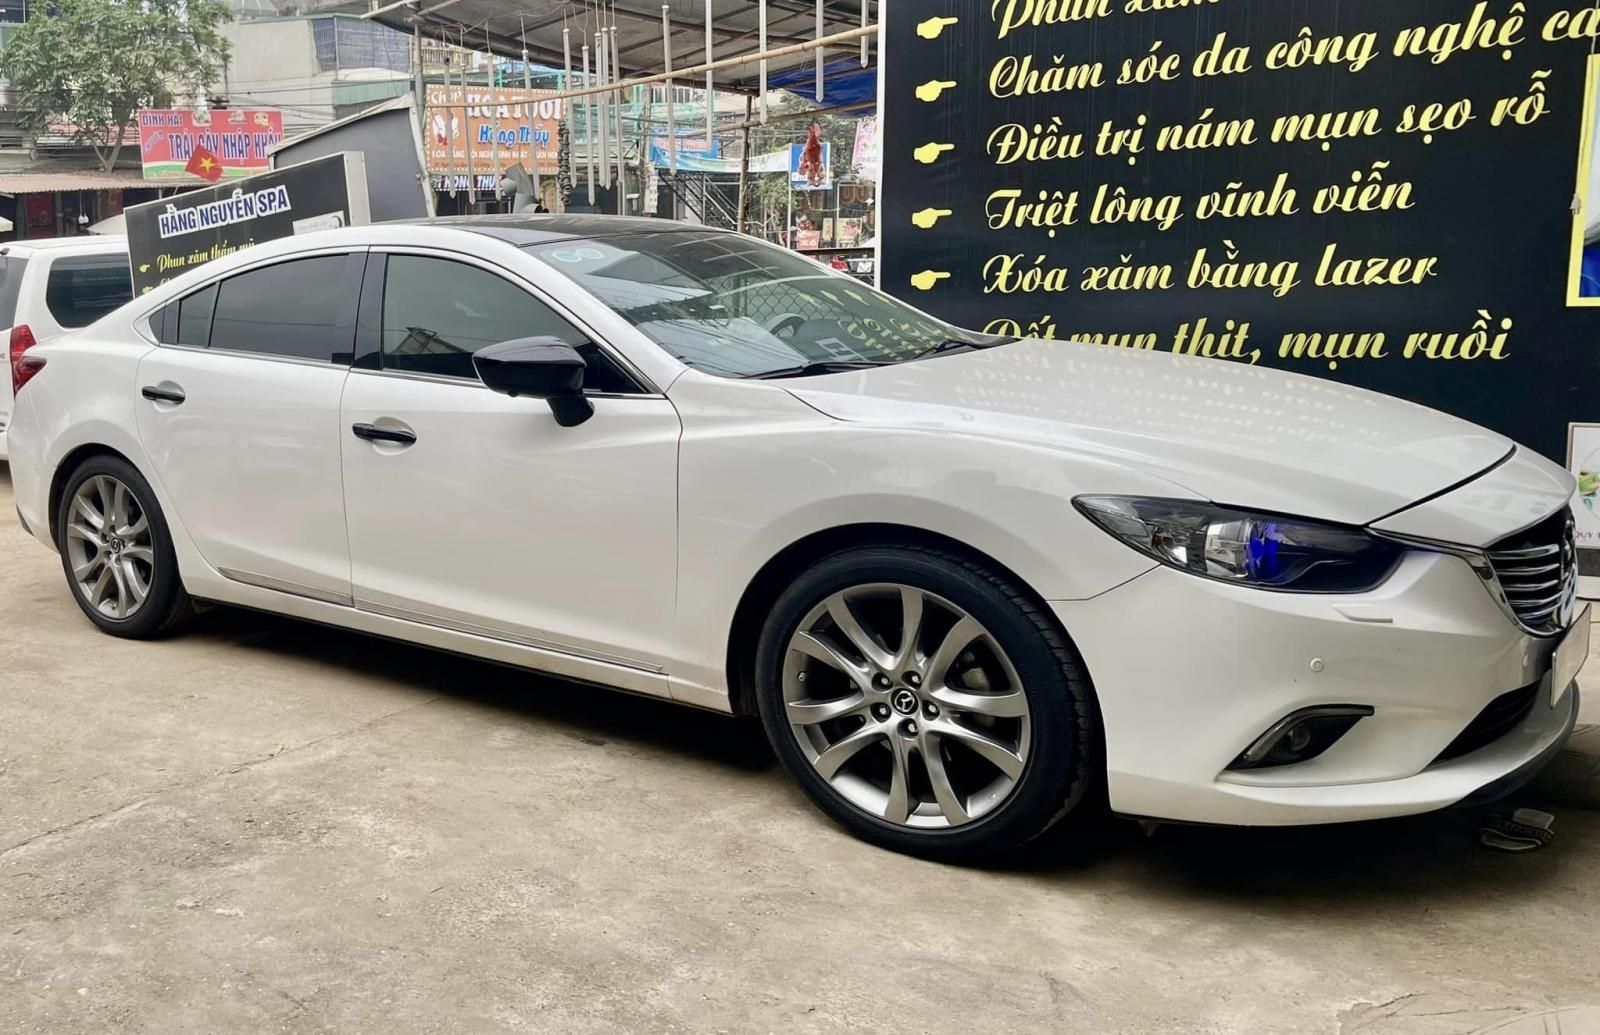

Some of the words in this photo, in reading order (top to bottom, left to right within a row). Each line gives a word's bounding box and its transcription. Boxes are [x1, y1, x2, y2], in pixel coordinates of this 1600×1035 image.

[989, 54, 1105, 98] Chăm
[1116, 40, 1180, 84] sóc
[1192, 32, 1251, 77] da
[1265, 26, 1379, 72] công
[1393, 1, 1525, 64] nghệ
[479, 121, 515, 148] Hng
[987, 116, 1083, 164] Điều
[1095, 114, 1147, 165] trị
[1156, 108, 1256, 151] nám
[1271, 108, 1381, 151] mụn
[1396, 99, 1476, 144] sẹo
[1491, 70, 1552, 126] rỗ
[160, 204, 197, 236] HẰNG
[198, 189, 255, 229] NGUYỄN
[258, 186, 289, 214] SPA
[986, 189, 1078, 238] Triệt
[1089, 184, 1183, 230] lông
[1195, 172, 1299, 218] vĩnh
[1312, 160, 1415, 214] viễn
[157, 254, 185, 273] Phun
[983, 254, 1068, 293] Xóa
[1080, 253, 1174, 290] xăm
[1187, 239, 1300, 297] bằng
[1314, 243, 1438, 286] lazer
[1278, 332, 1388, 370] mụn
[1403, 309, 1511, 360] ruồi
